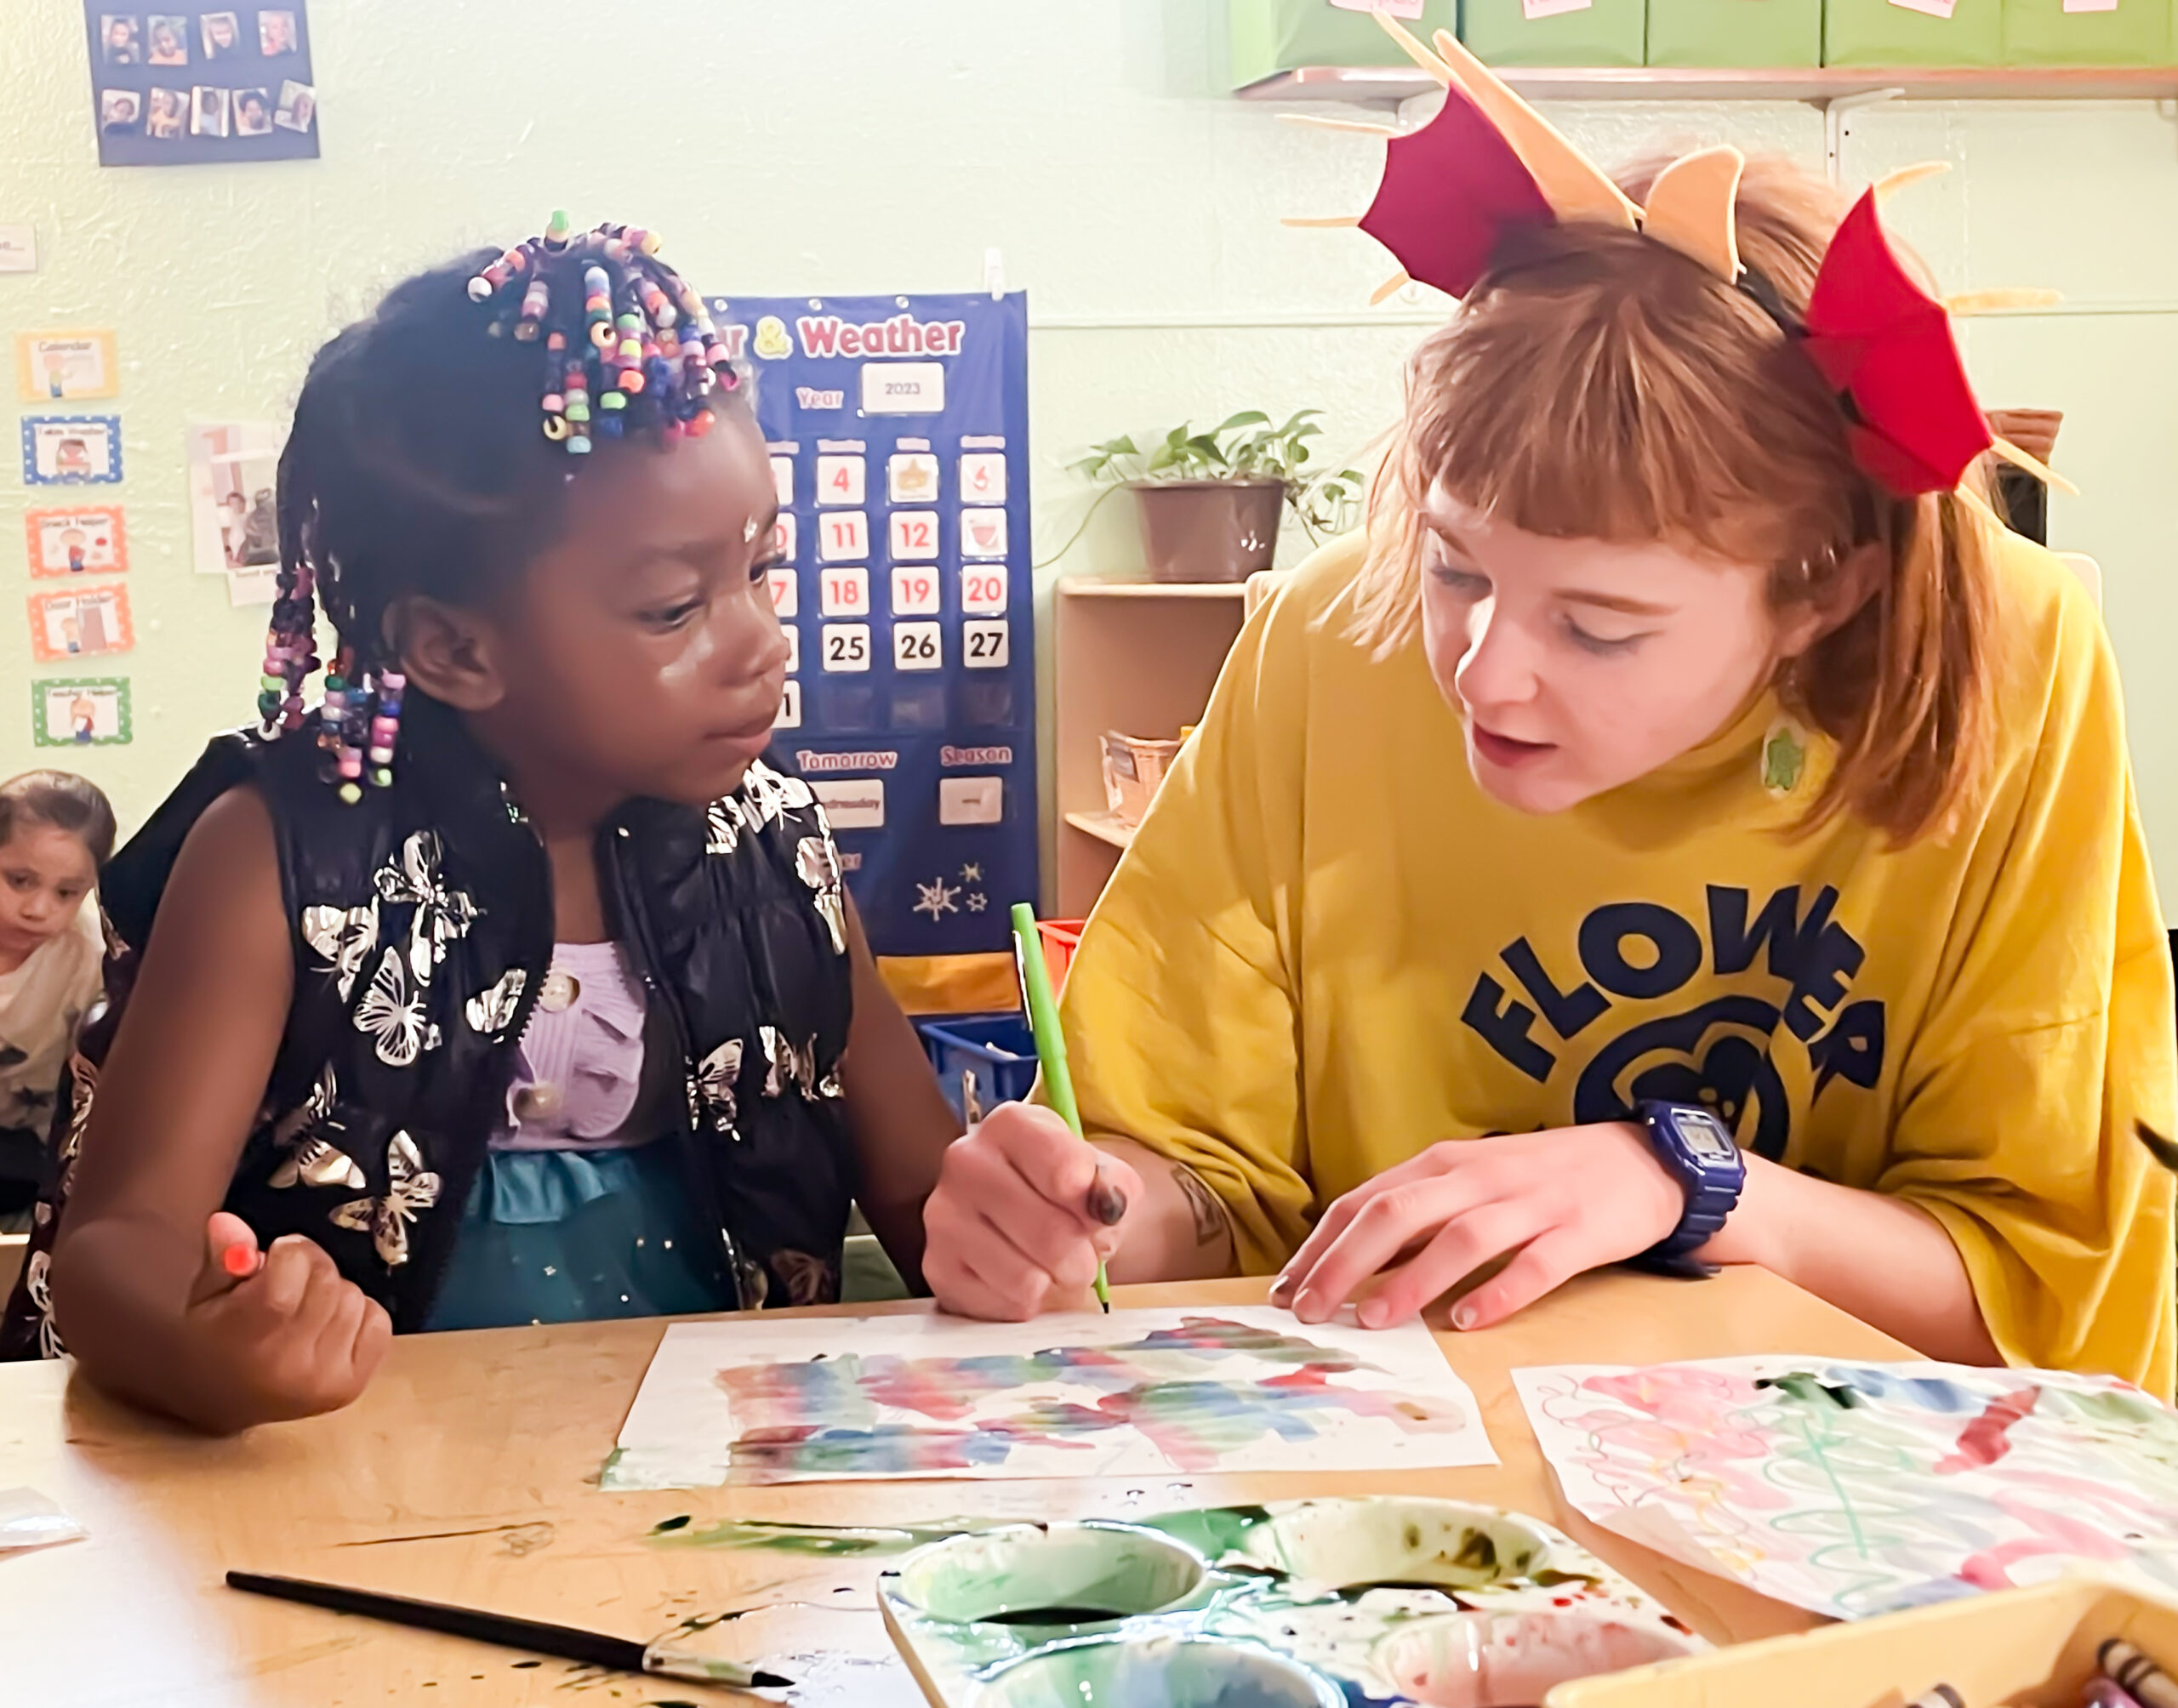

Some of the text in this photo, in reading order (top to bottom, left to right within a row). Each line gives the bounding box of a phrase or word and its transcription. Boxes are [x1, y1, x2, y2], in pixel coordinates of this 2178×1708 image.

[756, 316, 790, 357] &
[799, 316, 962, 356] Weather
[798, 390, 841, 407] Year
[885, 383, 921, 396] 2023
[832, 466, 850, 492] 4
[972, 465, 989, 491] 6
[832, 522, 856, 549] 11
[900, 522, 930, 548] 12
[830, 580, 858, 605] 18
[900, 578, 930, 604] 19
[967, 577, 1001, 601] 20
[830, 636, 864, 661] 25
[901, 634, 936, 659] 26
[970, 632, 1003, 658] 27
[798, 752, 896, 771] Tomorrow
[942, 745, 1011, 766] Season
[1460, 885, 1885, 1107] FLOWER
